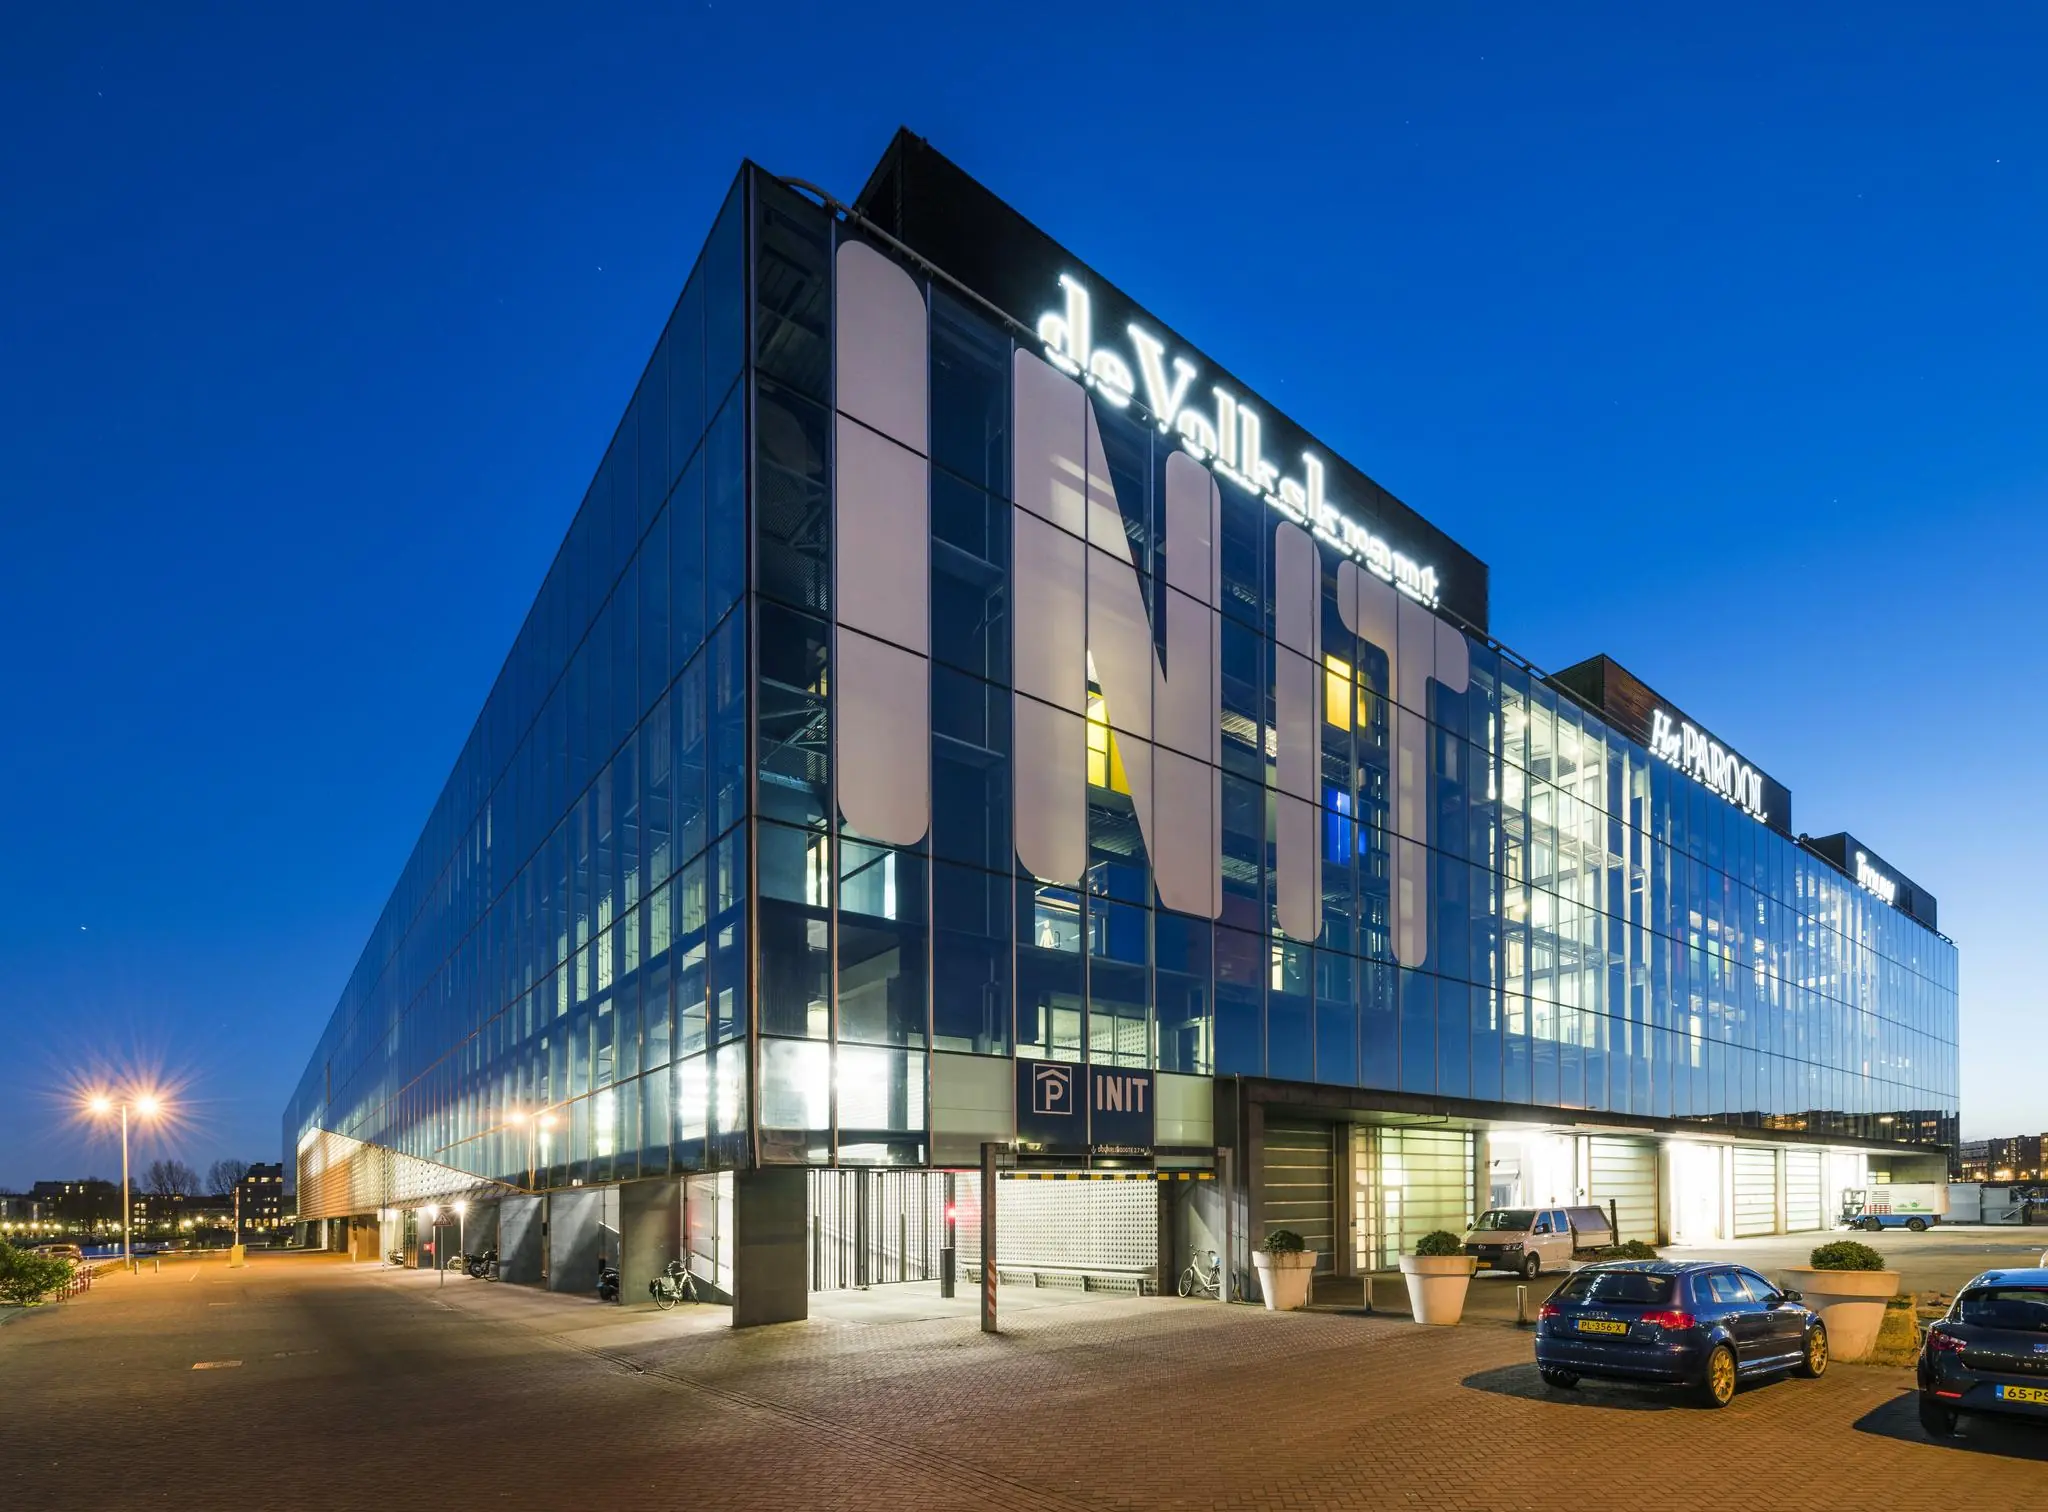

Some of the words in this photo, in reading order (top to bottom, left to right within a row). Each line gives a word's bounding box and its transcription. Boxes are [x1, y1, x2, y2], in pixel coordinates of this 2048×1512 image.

[1037, 274, 1135, 407] de
[836, 240, 1469, 968] INIT
[1649, 708, 1682, 768] Het
[1681, 722, 1767, 823] PAROOL
[1045, 1079, 1064, 1111] P
[1096, 1074, 1149, 1113] INIT
[1581, 1321, 1622, 1332] PL-356-X
